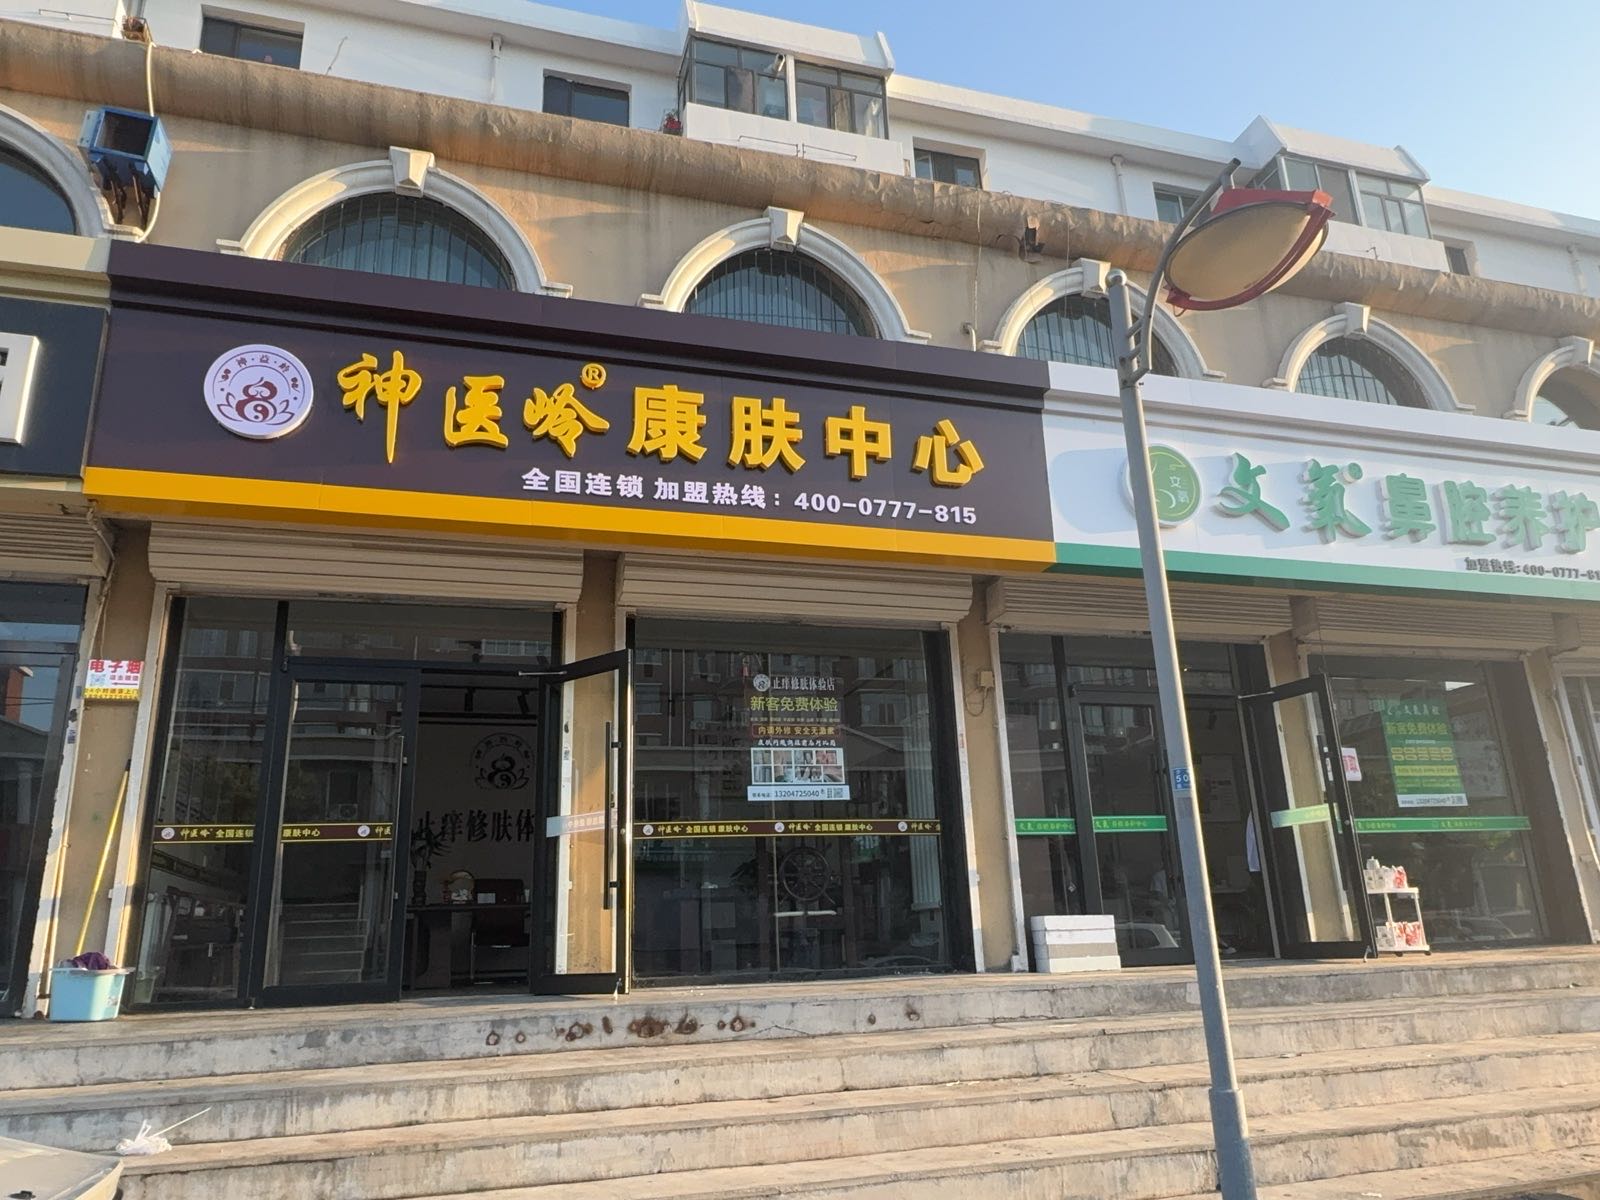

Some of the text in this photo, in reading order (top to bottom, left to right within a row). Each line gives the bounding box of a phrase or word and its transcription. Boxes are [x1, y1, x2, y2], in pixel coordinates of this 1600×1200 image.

[521, 467, 644, 499] 全国连锁
[90, 658, 141, 674] 电子烟
[773, 676, 835, 691] 止痒修肤体验店
[750, 696, 838, 712] 新客免费体验
[794, 726, 835, 735] 安全无激素
[685, 825, 717, 834] 全国连锁
[814, 823, 843, 832] 全国连锁
